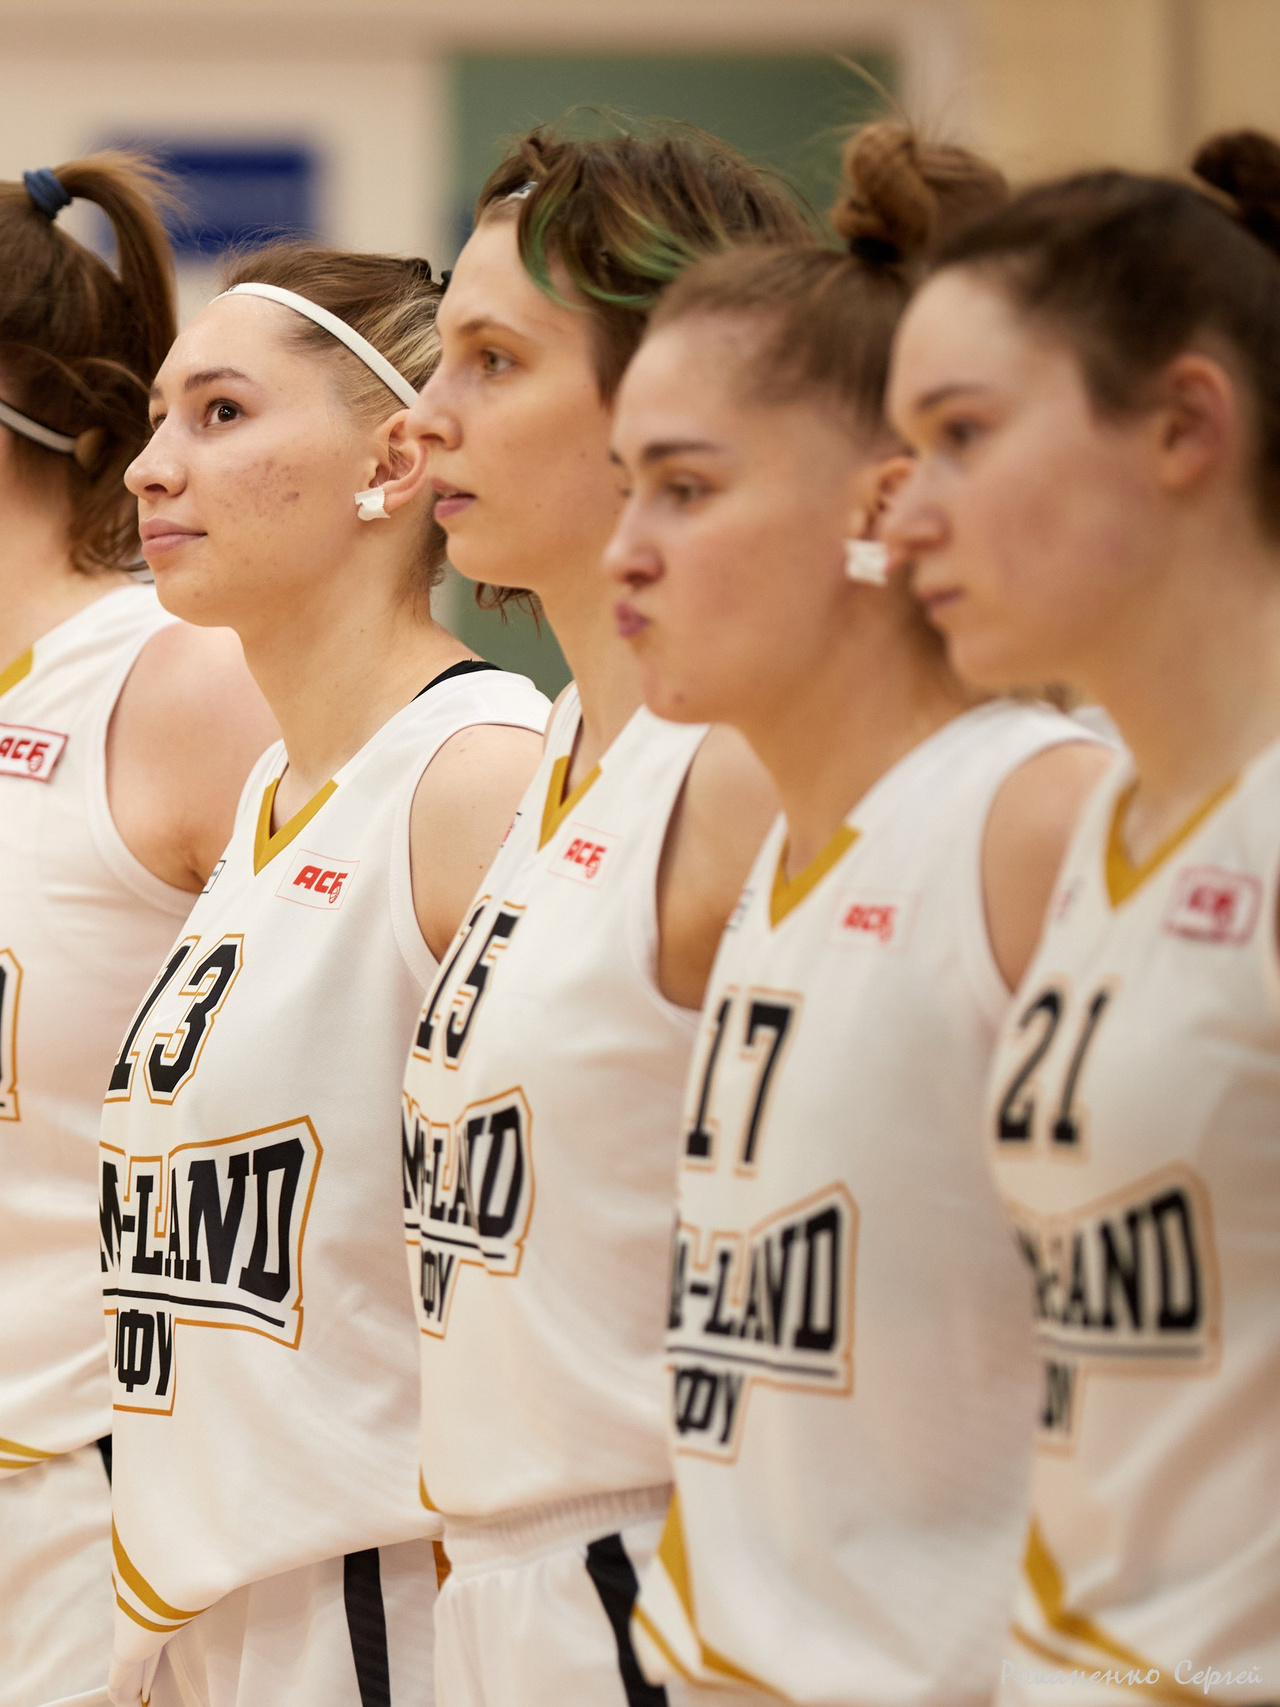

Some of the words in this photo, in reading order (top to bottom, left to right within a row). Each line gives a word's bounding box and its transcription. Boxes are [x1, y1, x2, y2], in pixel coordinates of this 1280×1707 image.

[107, 942, 239, 1094] 13
[414, 904, 521, 1060] 15
[684, 998, 795, 1165] 17
[997, 988, 1111, 1145] 21
